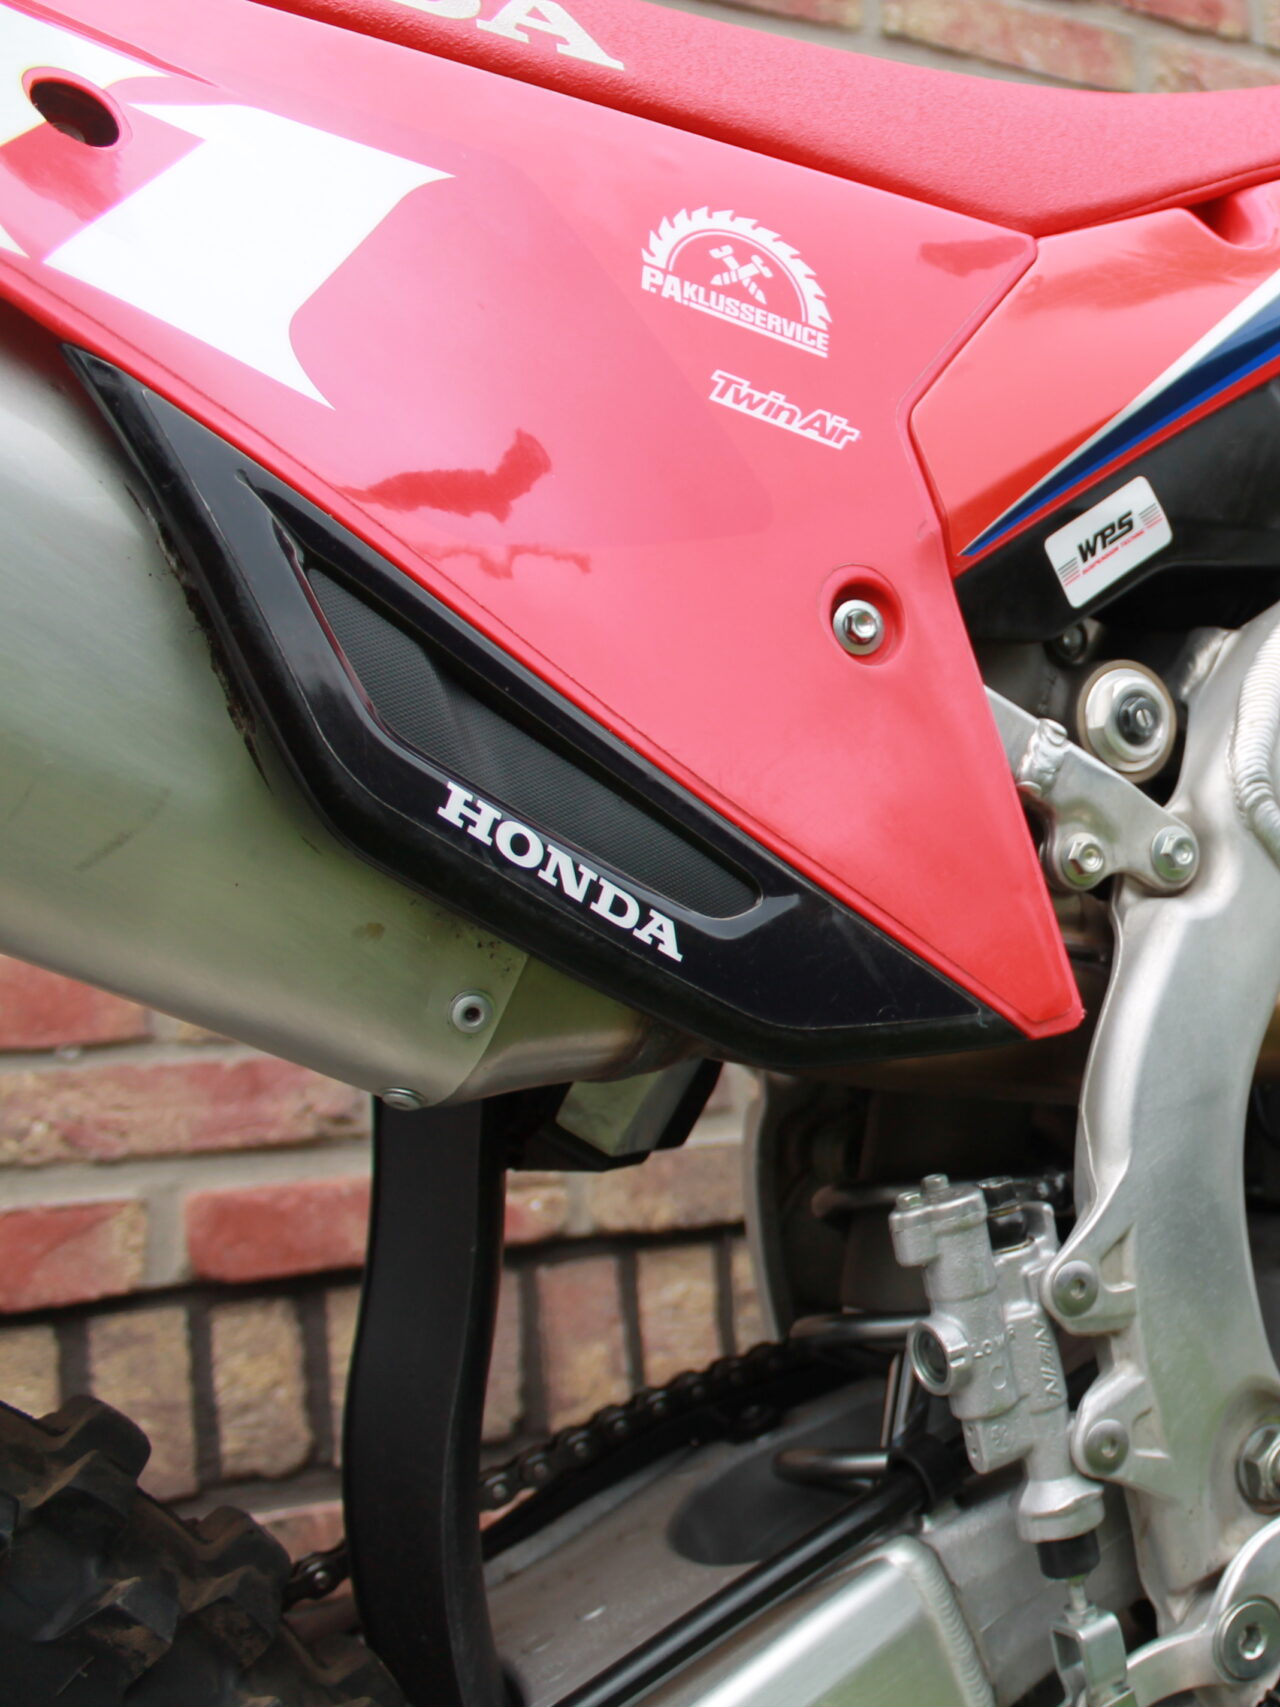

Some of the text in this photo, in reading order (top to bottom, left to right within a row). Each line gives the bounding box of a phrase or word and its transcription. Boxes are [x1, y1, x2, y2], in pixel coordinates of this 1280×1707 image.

[709, 369, 861, 450] Twin Air
[1078, 510, 1134, 564] WPS
[437, 781, 683, 962] HONDA
